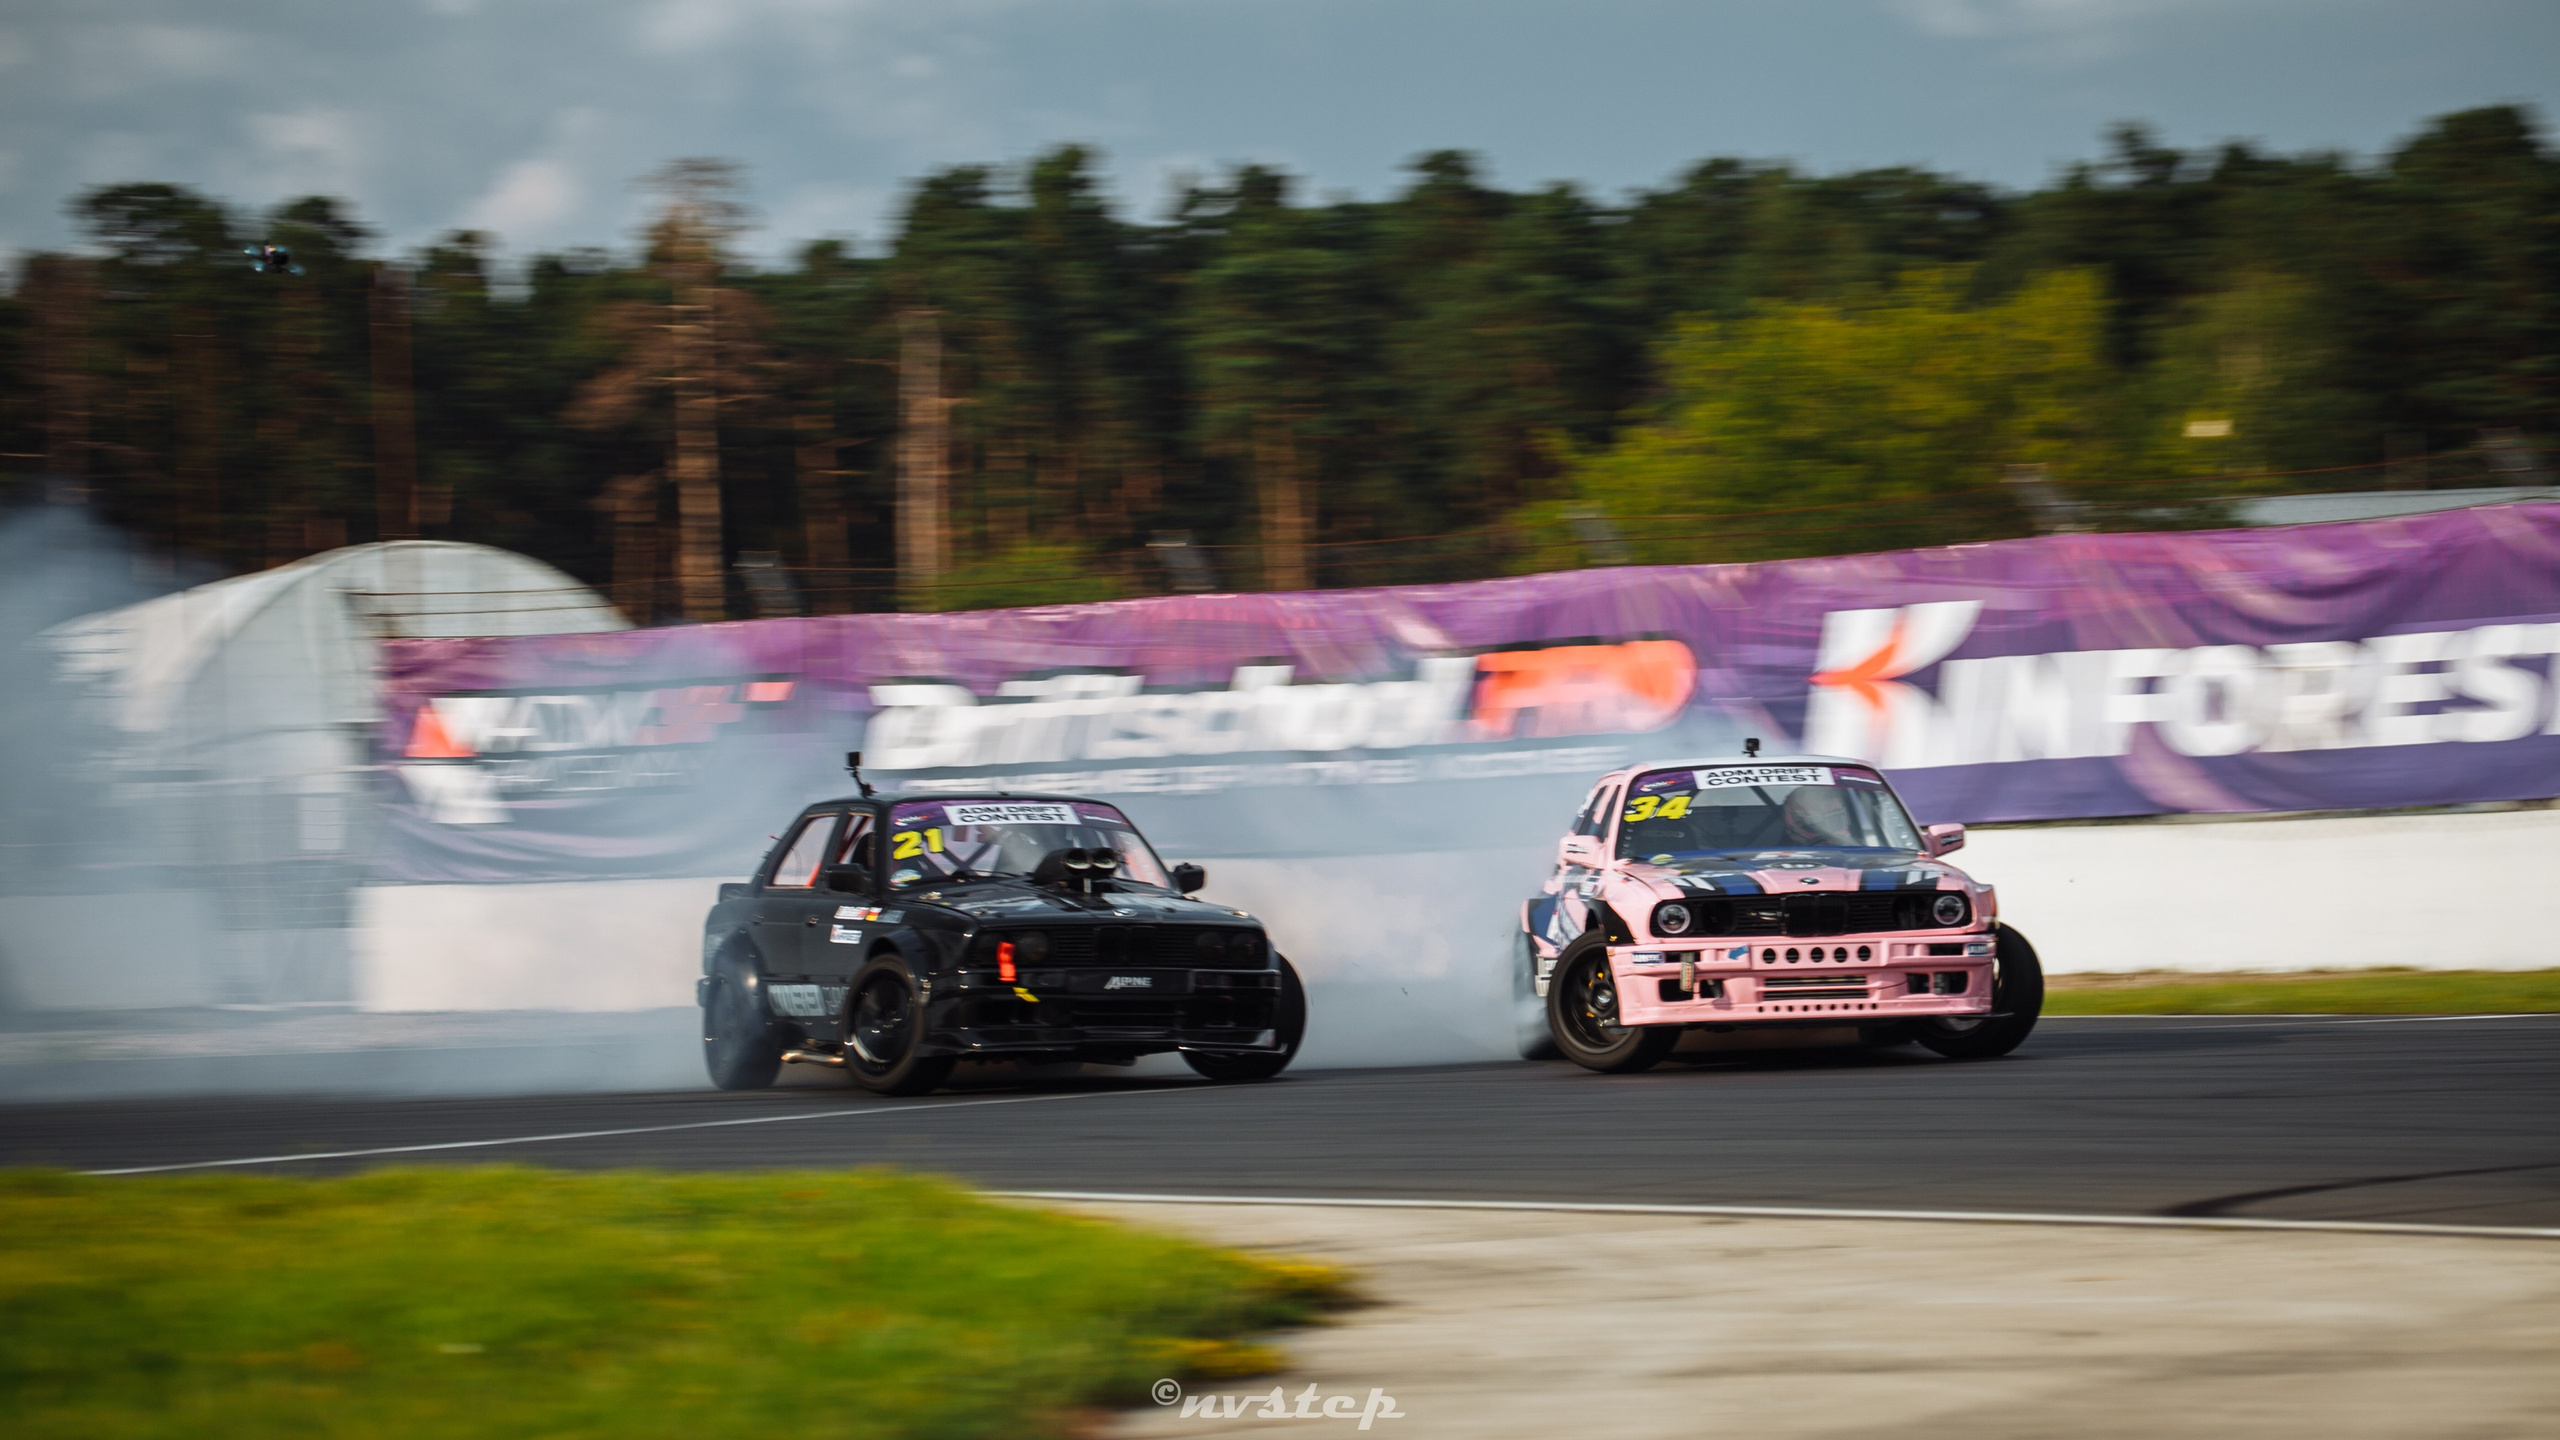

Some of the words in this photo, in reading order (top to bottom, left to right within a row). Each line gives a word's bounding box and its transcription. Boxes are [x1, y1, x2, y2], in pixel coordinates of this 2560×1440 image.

[1706, 769, 1755, 779] ADM
[1758, 767, 1820, 776] DRIFT
[1708, 774, 1822, 786] CONTEST
[957, 804, 1007, 815] ADM
[1009, 803, 1064, 815] DRIFT
[1624, 796, 1692, 823] 34
[960, 812, 1067, 823] CONTEST
[892, 828, 944, 861] 21
